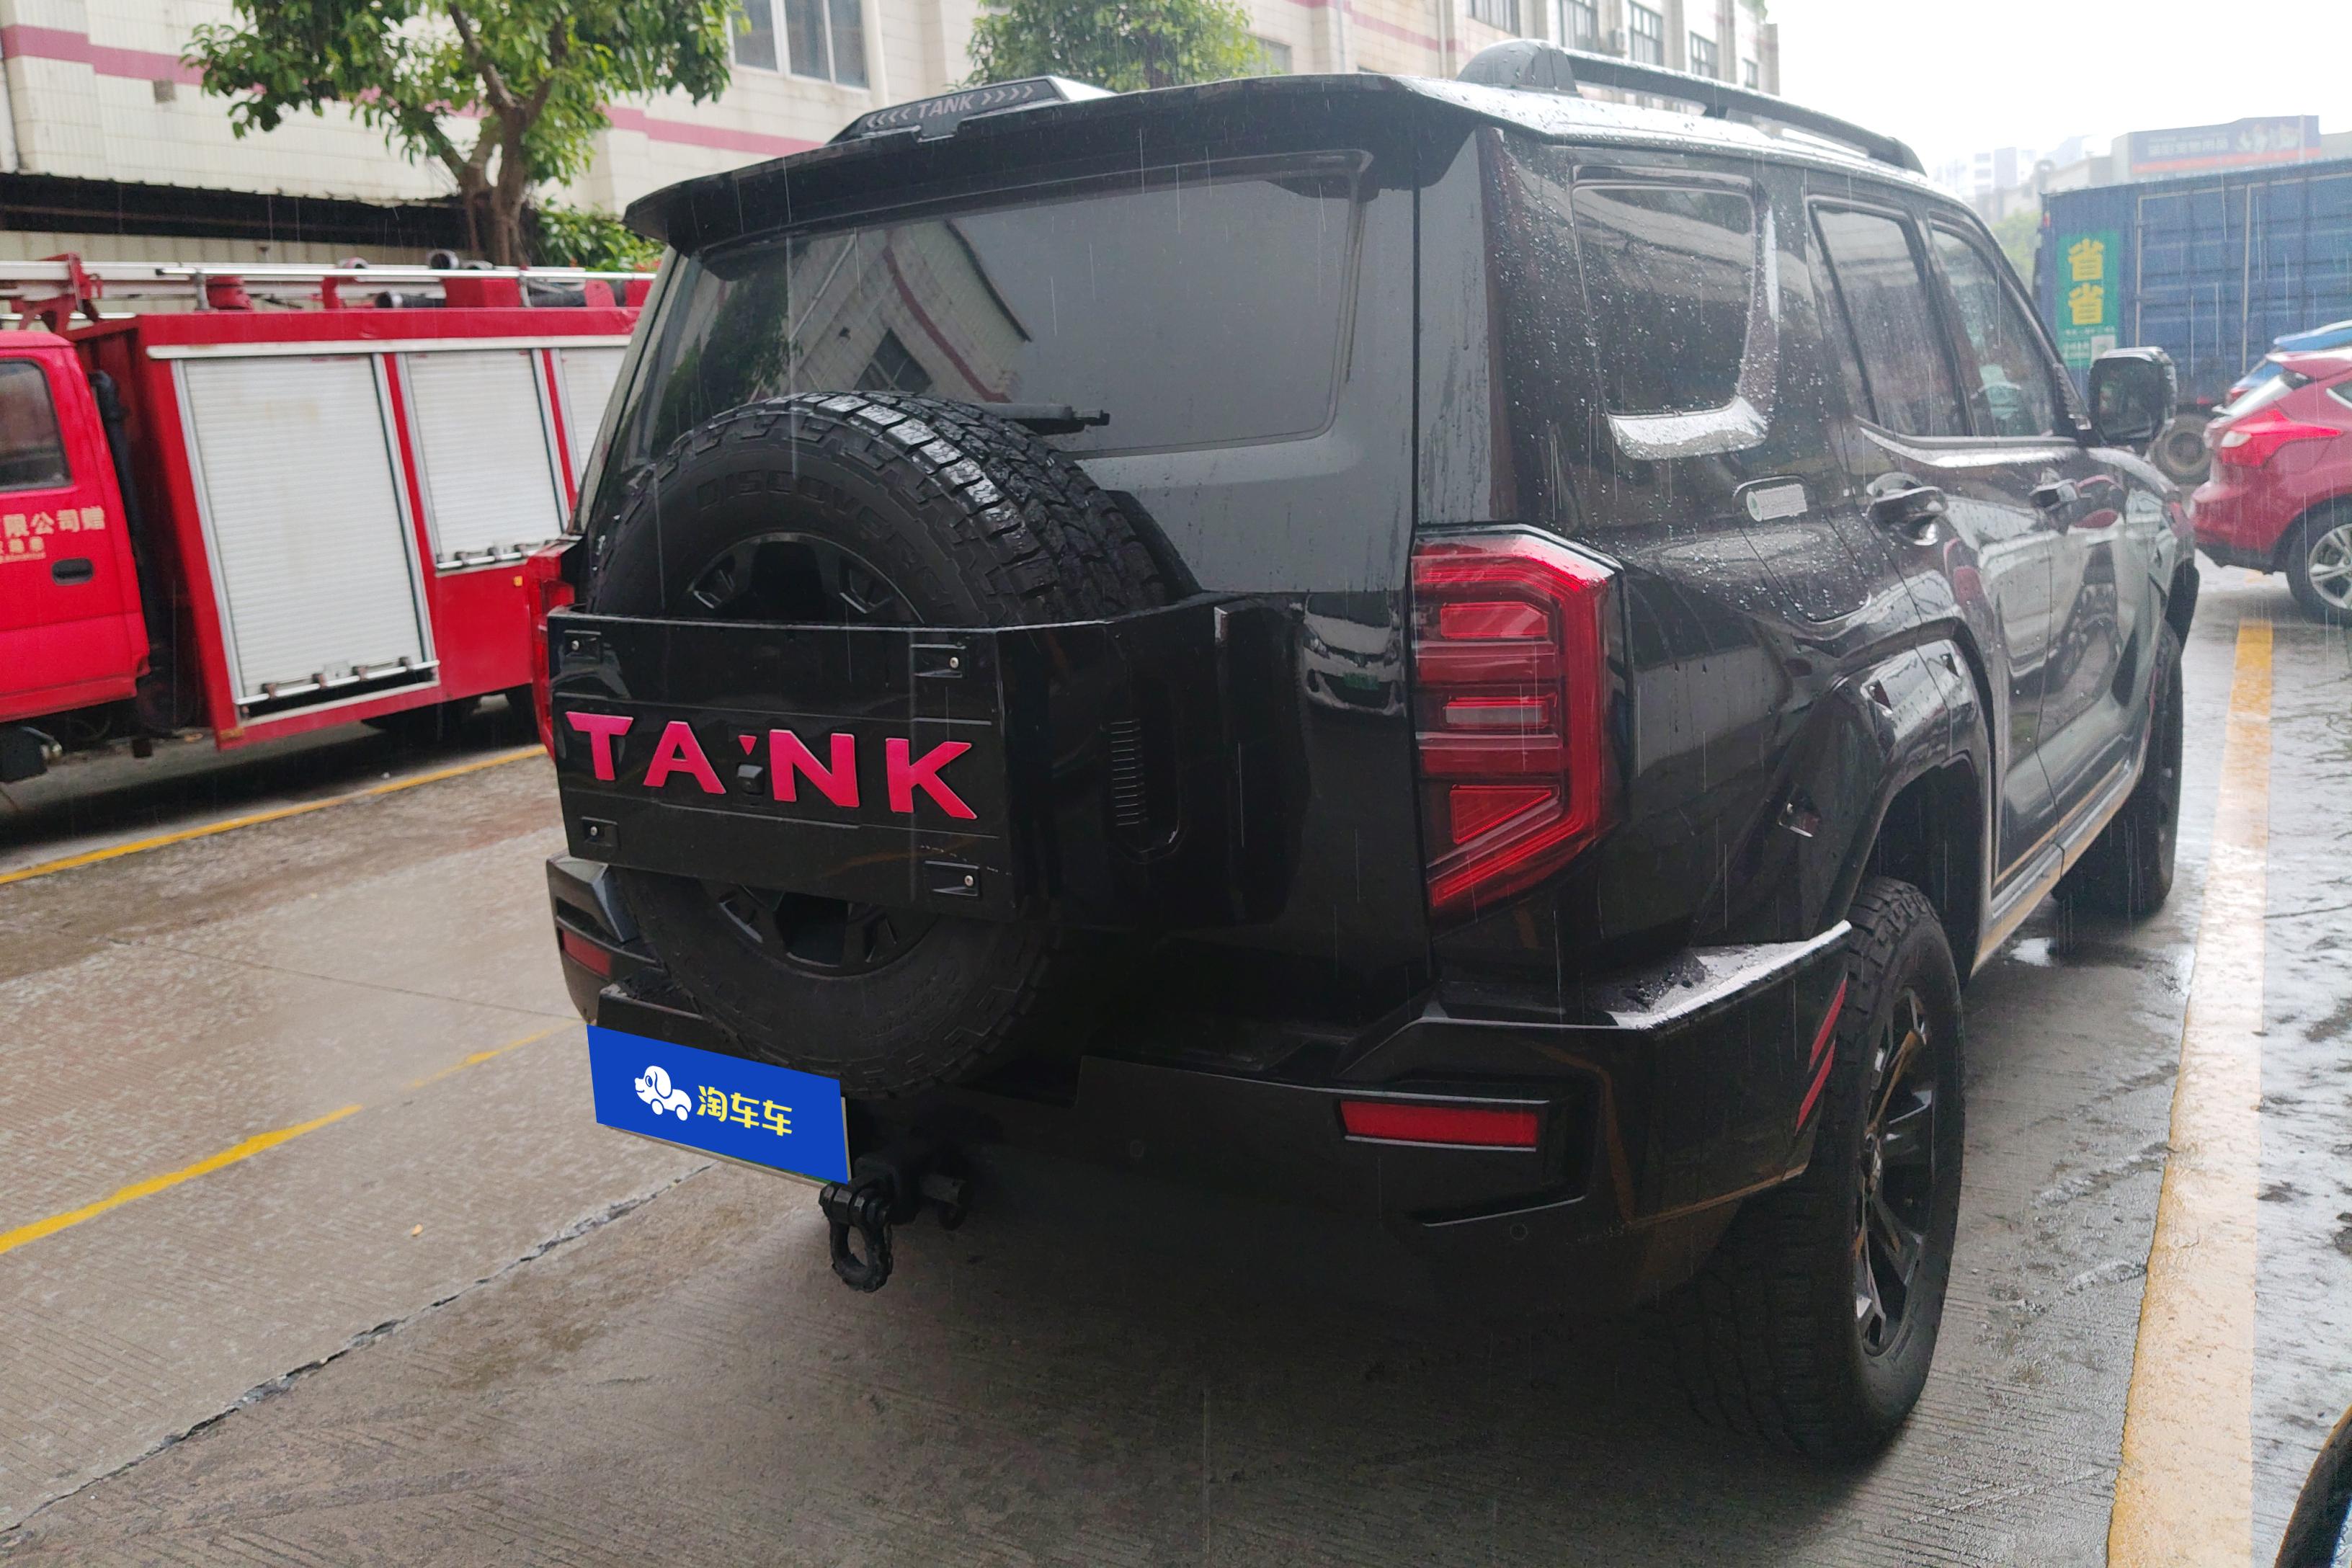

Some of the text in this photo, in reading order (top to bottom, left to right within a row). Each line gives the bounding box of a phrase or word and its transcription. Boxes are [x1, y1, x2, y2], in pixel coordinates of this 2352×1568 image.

[919, 94, 974, 119] TANK
[2067, 239, 2105, 325] 省省
[565, 710, 978, 820] TANK
